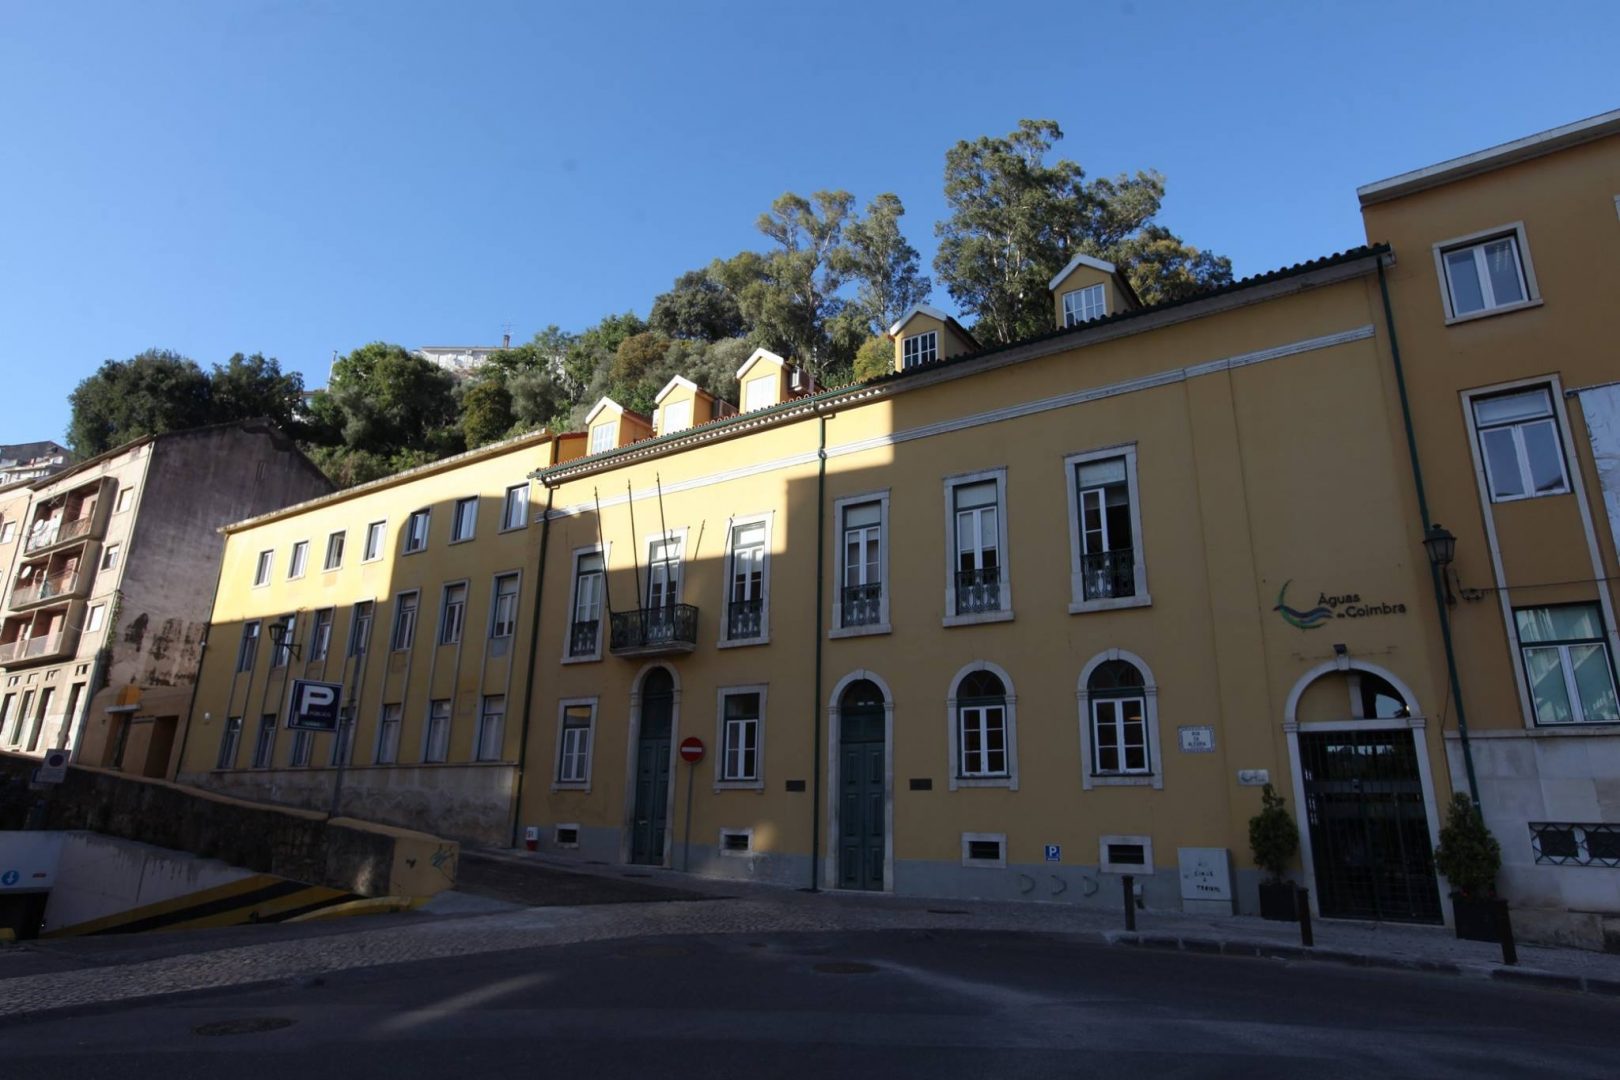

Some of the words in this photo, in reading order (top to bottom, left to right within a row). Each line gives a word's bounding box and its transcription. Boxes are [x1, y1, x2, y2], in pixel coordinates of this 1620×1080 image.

[1318, 593, 1360, 607] Águas
[1346, 602, 1406, 618] Coimbra
[300, 684, 334, 715] P
[1049, 846, 1057, 857] P
